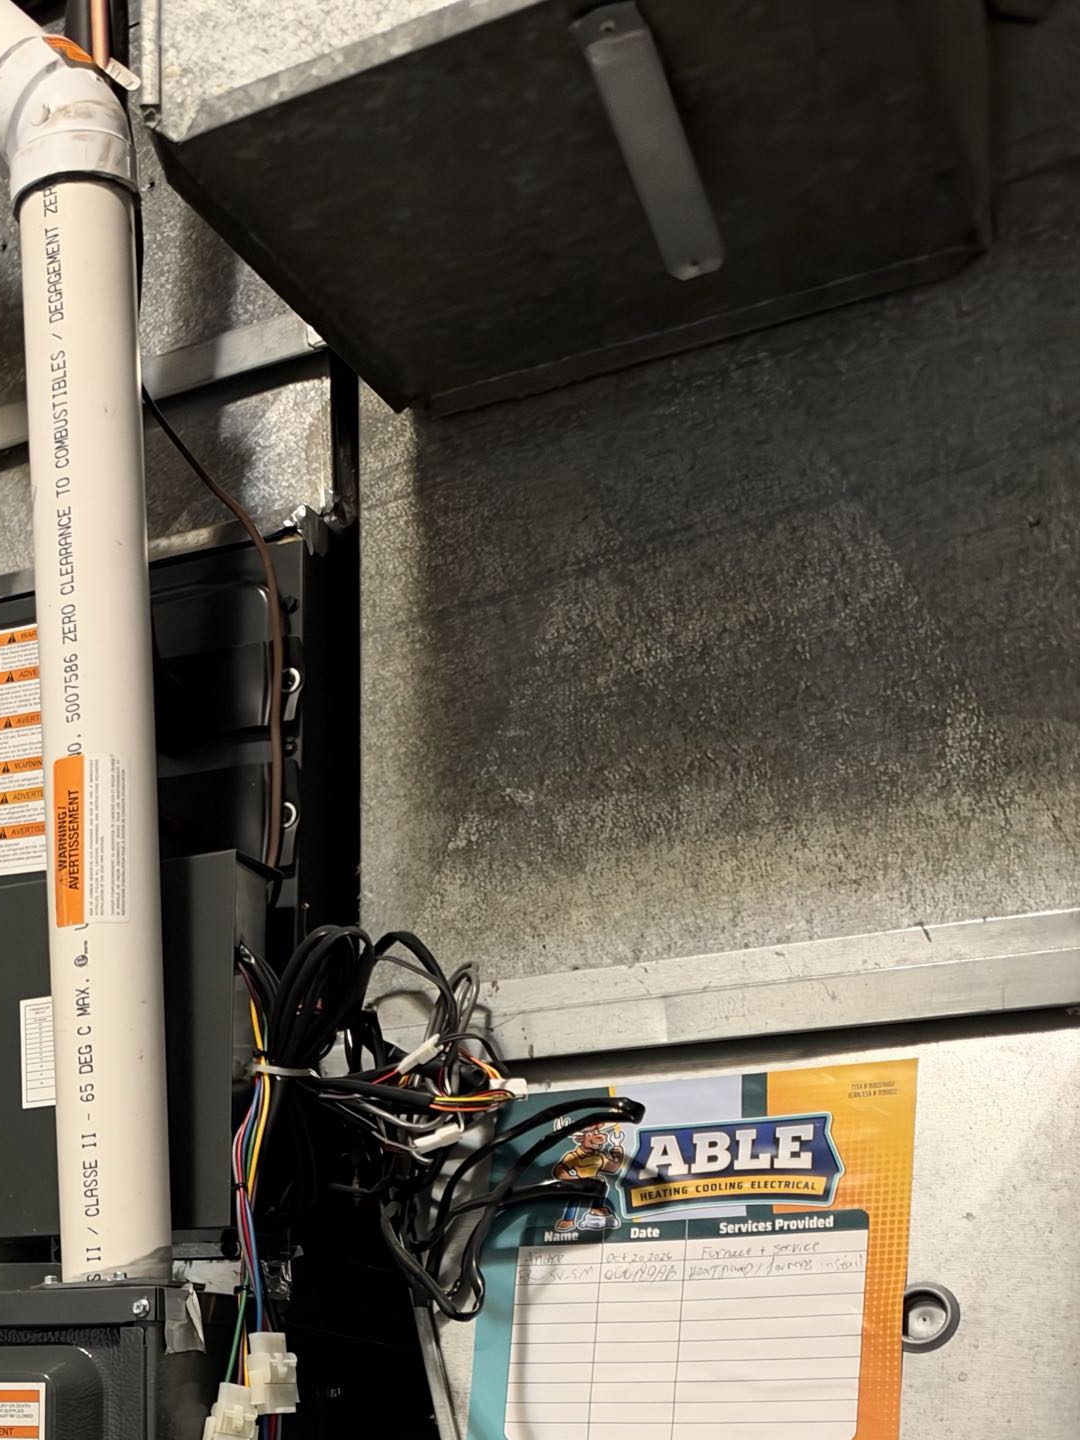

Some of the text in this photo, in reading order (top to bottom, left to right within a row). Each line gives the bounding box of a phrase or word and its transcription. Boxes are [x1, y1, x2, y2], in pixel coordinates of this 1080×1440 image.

[44, 225, 65, 325] DEGAGEMENT
[49, 349, 71, 470] COMBUSTIBLES
[56, 476, 71, 500] TO
[56, 505, 75, 597] CLEARANCE
[60, 603, 76, 643] ZERO
[63, 652, 82, 724] 5007586
[67, 789, 80, 891] AVERTISSEMENT
[76, 978, 92, 1018] MAX.
[77, 1024, 92, 1037] C
[78, 1043, 94, 1075] DEG
[79, 1082, 95, 1103] 65
[637, 1124, 815, 1181] ABLE
[82, 1158, 100, 1218] CLASSE
[639, 1179, 818, 1202] HEATING COOLING ELECTRICAL
[544, 1216, 834, 1243] Name Date Services Provided
